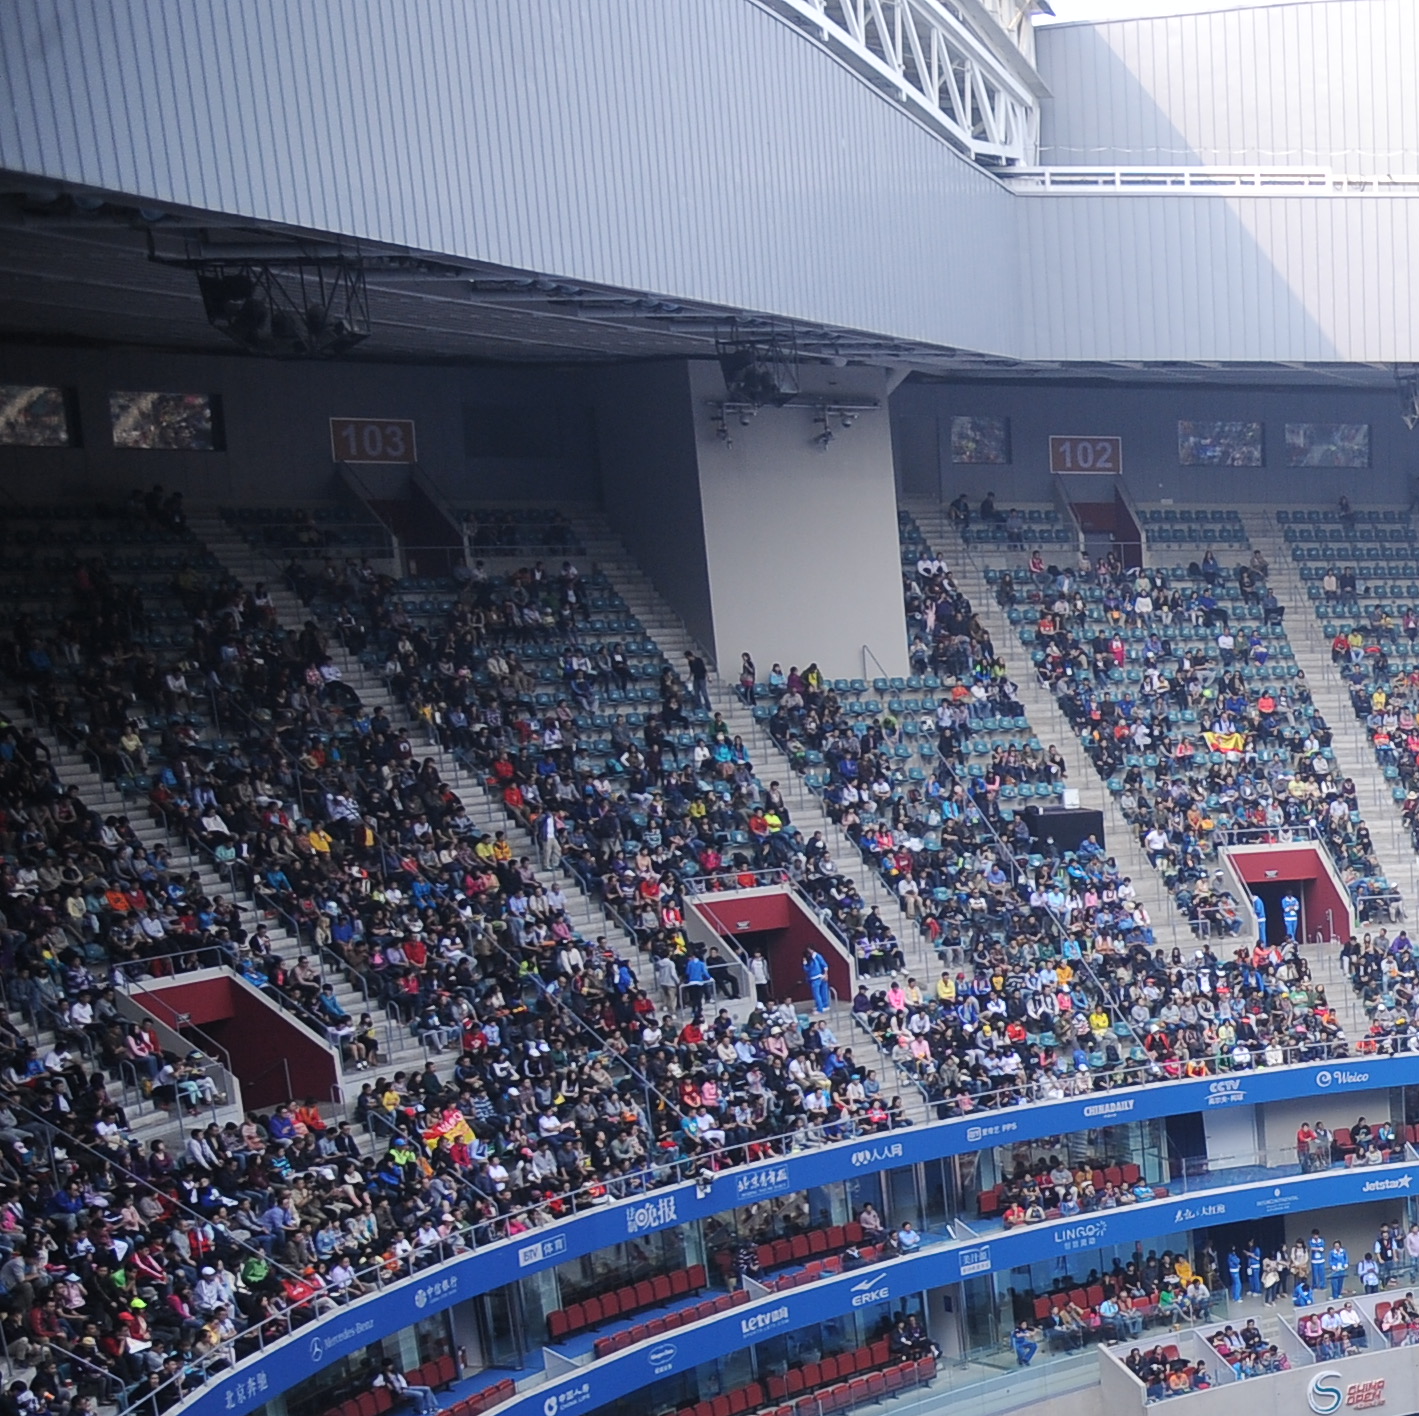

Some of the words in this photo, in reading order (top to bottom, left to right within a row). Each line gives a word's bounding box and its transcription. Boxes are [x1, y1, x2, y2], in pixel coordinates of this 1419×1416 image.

[342, 424, 405, 457] 103
[1060, 442, 1113, 468] 102
[1209, 1079, 1241, 1093] CCTV
[871, 1143, 903, 1161] 人人网
[1362, 1179, 1401, 1192] Jetstar
[852, 1287, 889, 1306] ERKE
